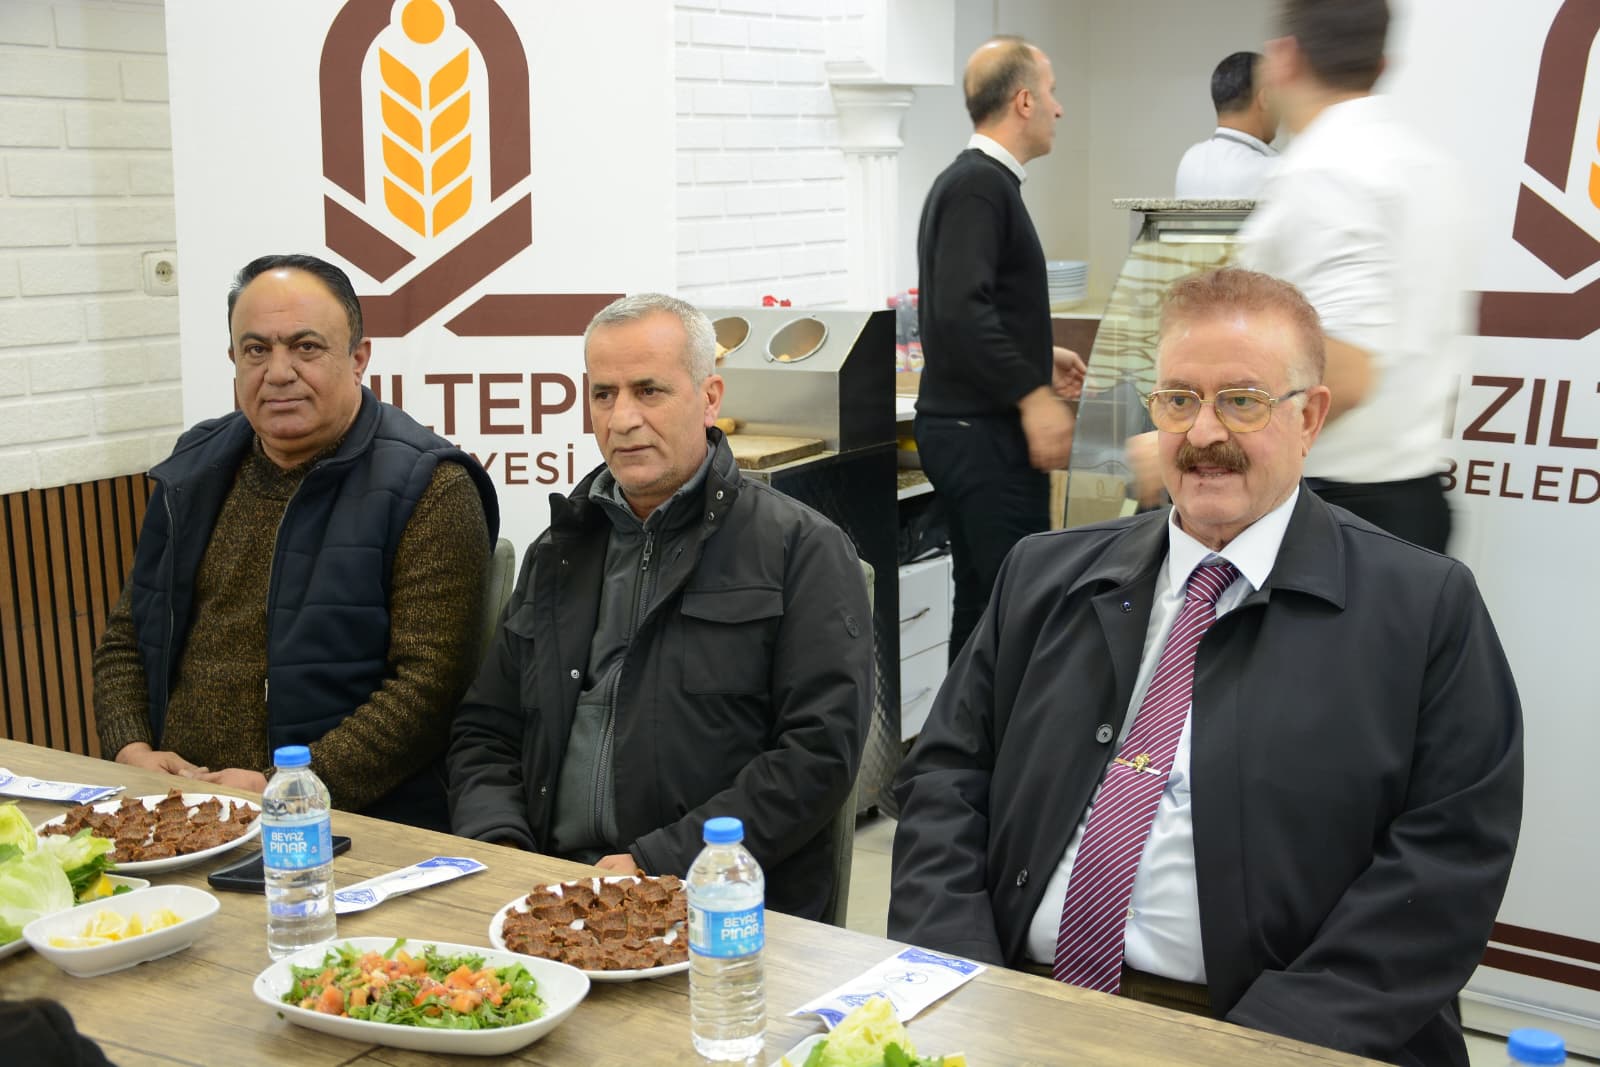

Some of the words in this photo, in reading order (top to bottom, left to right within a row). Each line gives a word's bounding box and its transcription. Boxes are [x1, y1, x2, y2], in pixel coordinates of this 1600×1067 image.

[271, 831, 305, 842] BEYAZ
[269, 841, 308, 854] PINAR
[723, 912, 758, 928] BEYAZ
[721, 922, 760, 940] PINAR
